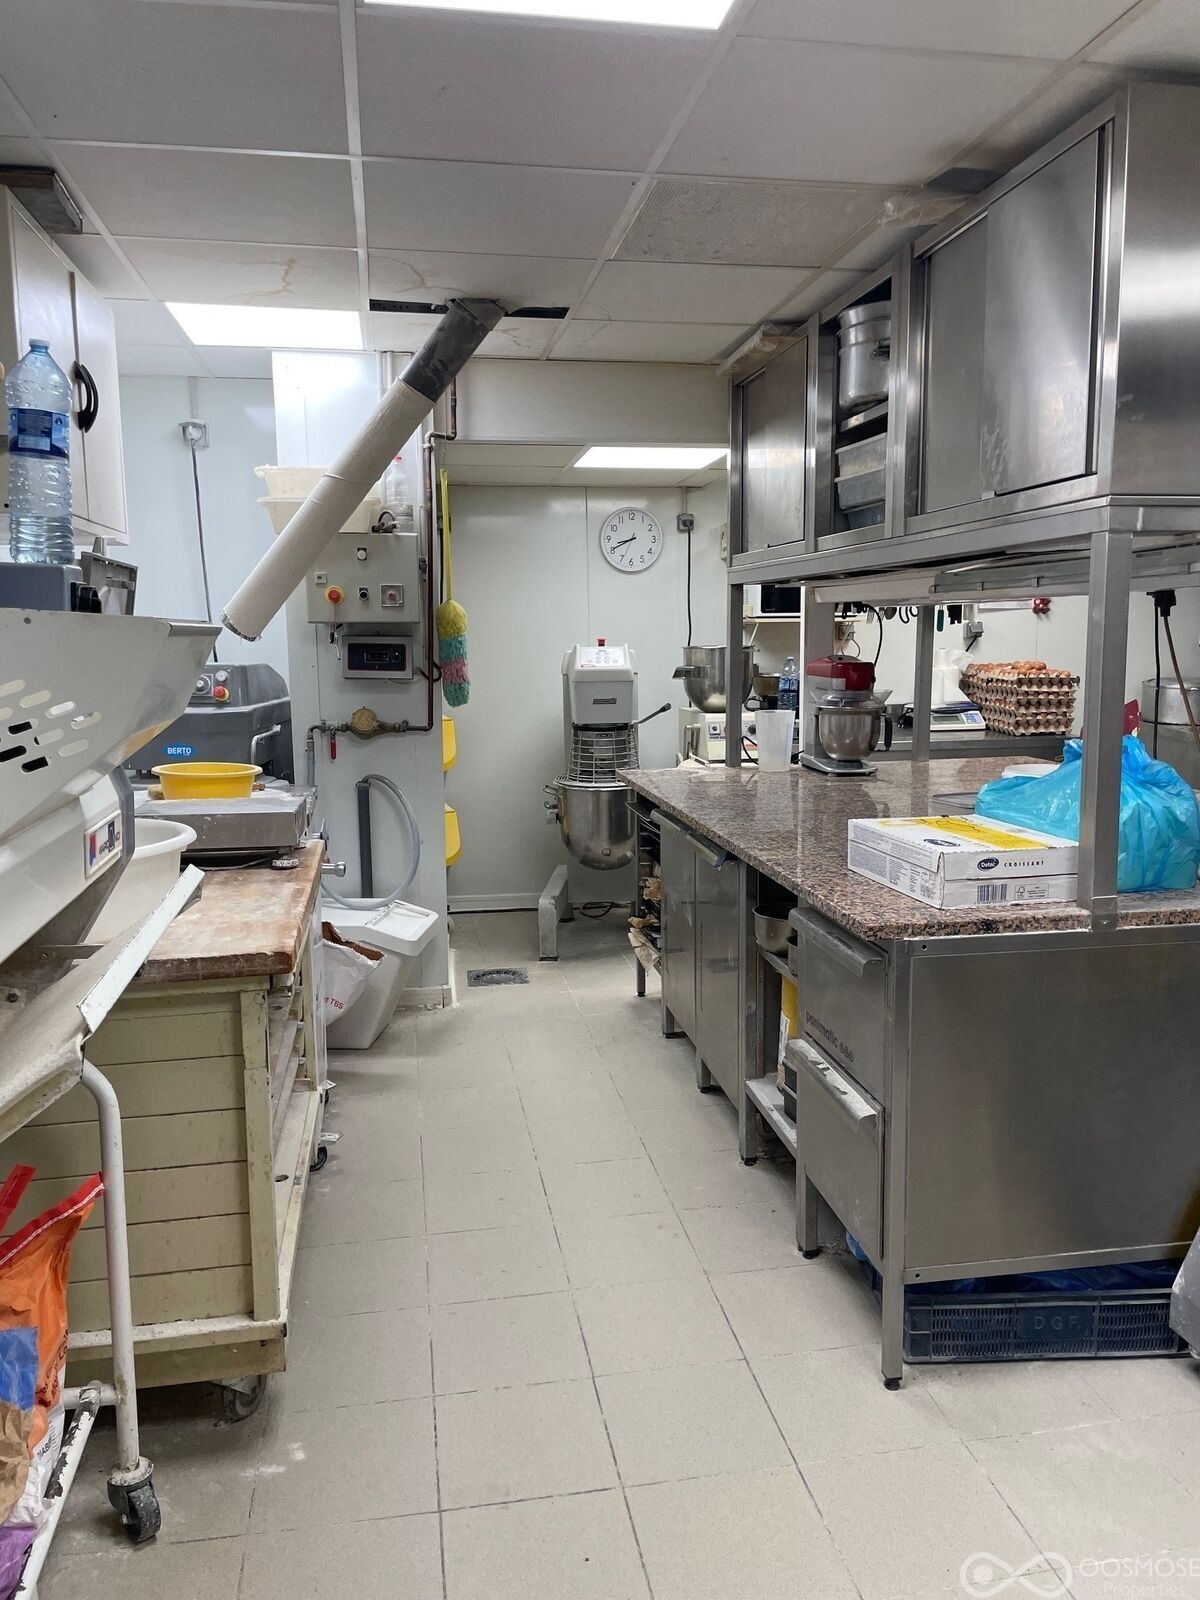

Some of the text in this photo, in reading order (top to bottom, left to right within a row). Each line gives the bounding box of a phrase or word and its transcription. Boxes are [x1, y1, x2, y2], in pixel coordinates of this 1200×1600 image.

[618, 516, 624, 524] 11
[628, 512, 636, 520] 12
[610, 524, 618, 532] 10
[648, 523, 653, 532] 2
[606, 535, 612, 543] 9
[651, 535, 656, 543] 3
[610, 546, 616, 554] 8
[619, 554, 625, 562] 7
[628, 557, 634, 566] 6
[640, 555, 645, 563] 5
[167, 747, 192, 755] BERTO
[330, 997, 344, 1009] T65
